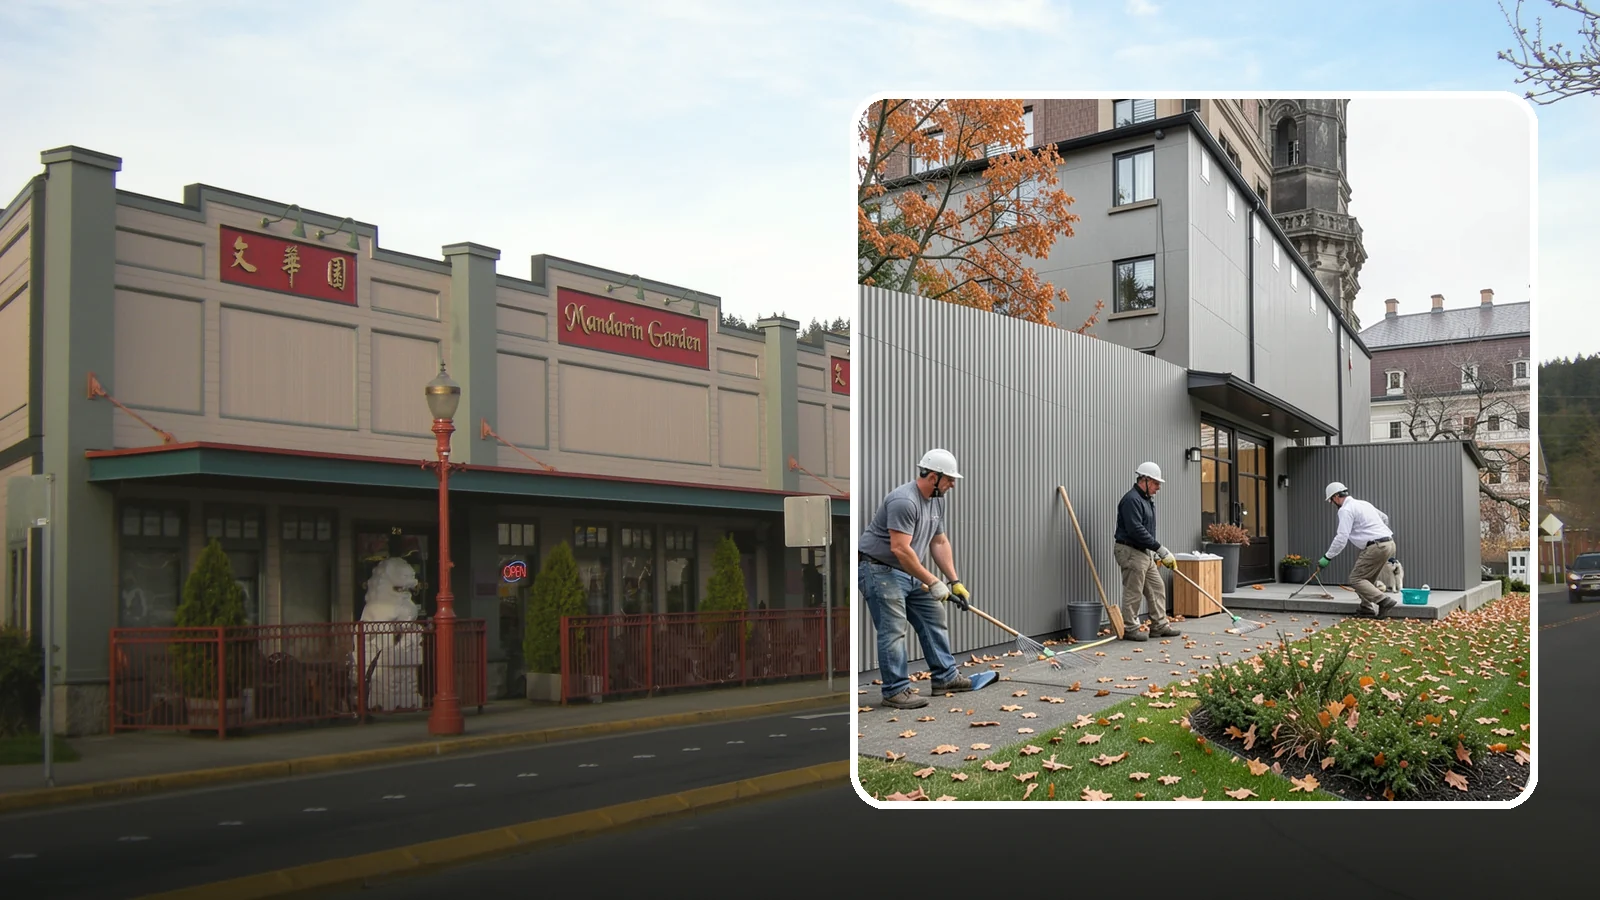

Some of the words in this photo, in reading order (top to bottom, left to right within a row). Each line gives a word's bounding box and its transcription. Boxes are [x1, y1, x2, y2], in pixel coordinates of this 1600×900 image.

[231, 236, 345, 291] 文華園
[564, 302, 644, 341] Mandarin
[648, 320, 701, 352] Garden
[503, 565, 527, 578] OPEN
